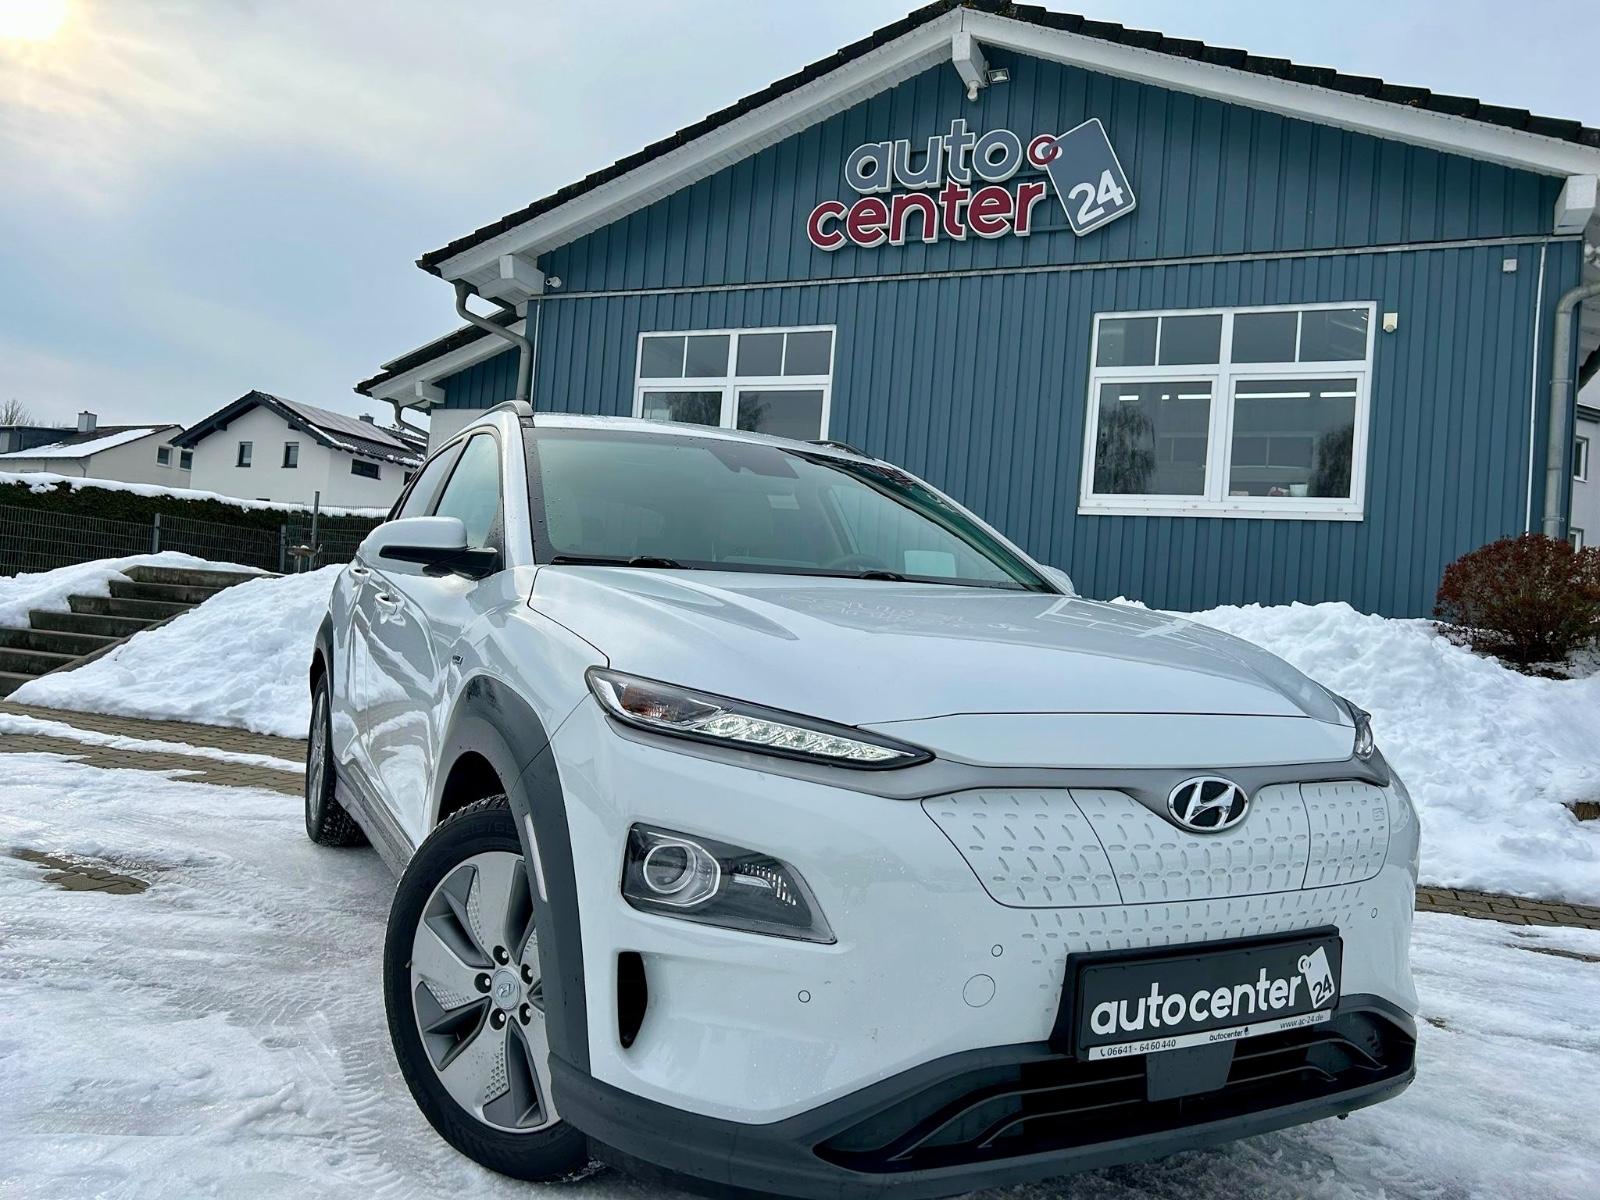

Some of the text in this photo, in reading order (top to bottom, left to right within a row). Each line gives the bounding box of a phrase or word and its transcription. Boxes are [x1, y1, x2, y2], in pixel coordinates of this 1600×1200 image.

[845, 118, 1023, 195] auto
[806, 176, 1047, 252] center
[1067, 169, 1124, 226] 24
[1089, 967, 1301, 1036] autocenter
[1312, 974, 1333, 1006] 24
[1209, 1029, 1244, 1042] autocenter
[1279, 1013, 1324, 1030] www.ac-24.de
[1107, 1045, 1132, 1057] 06641
